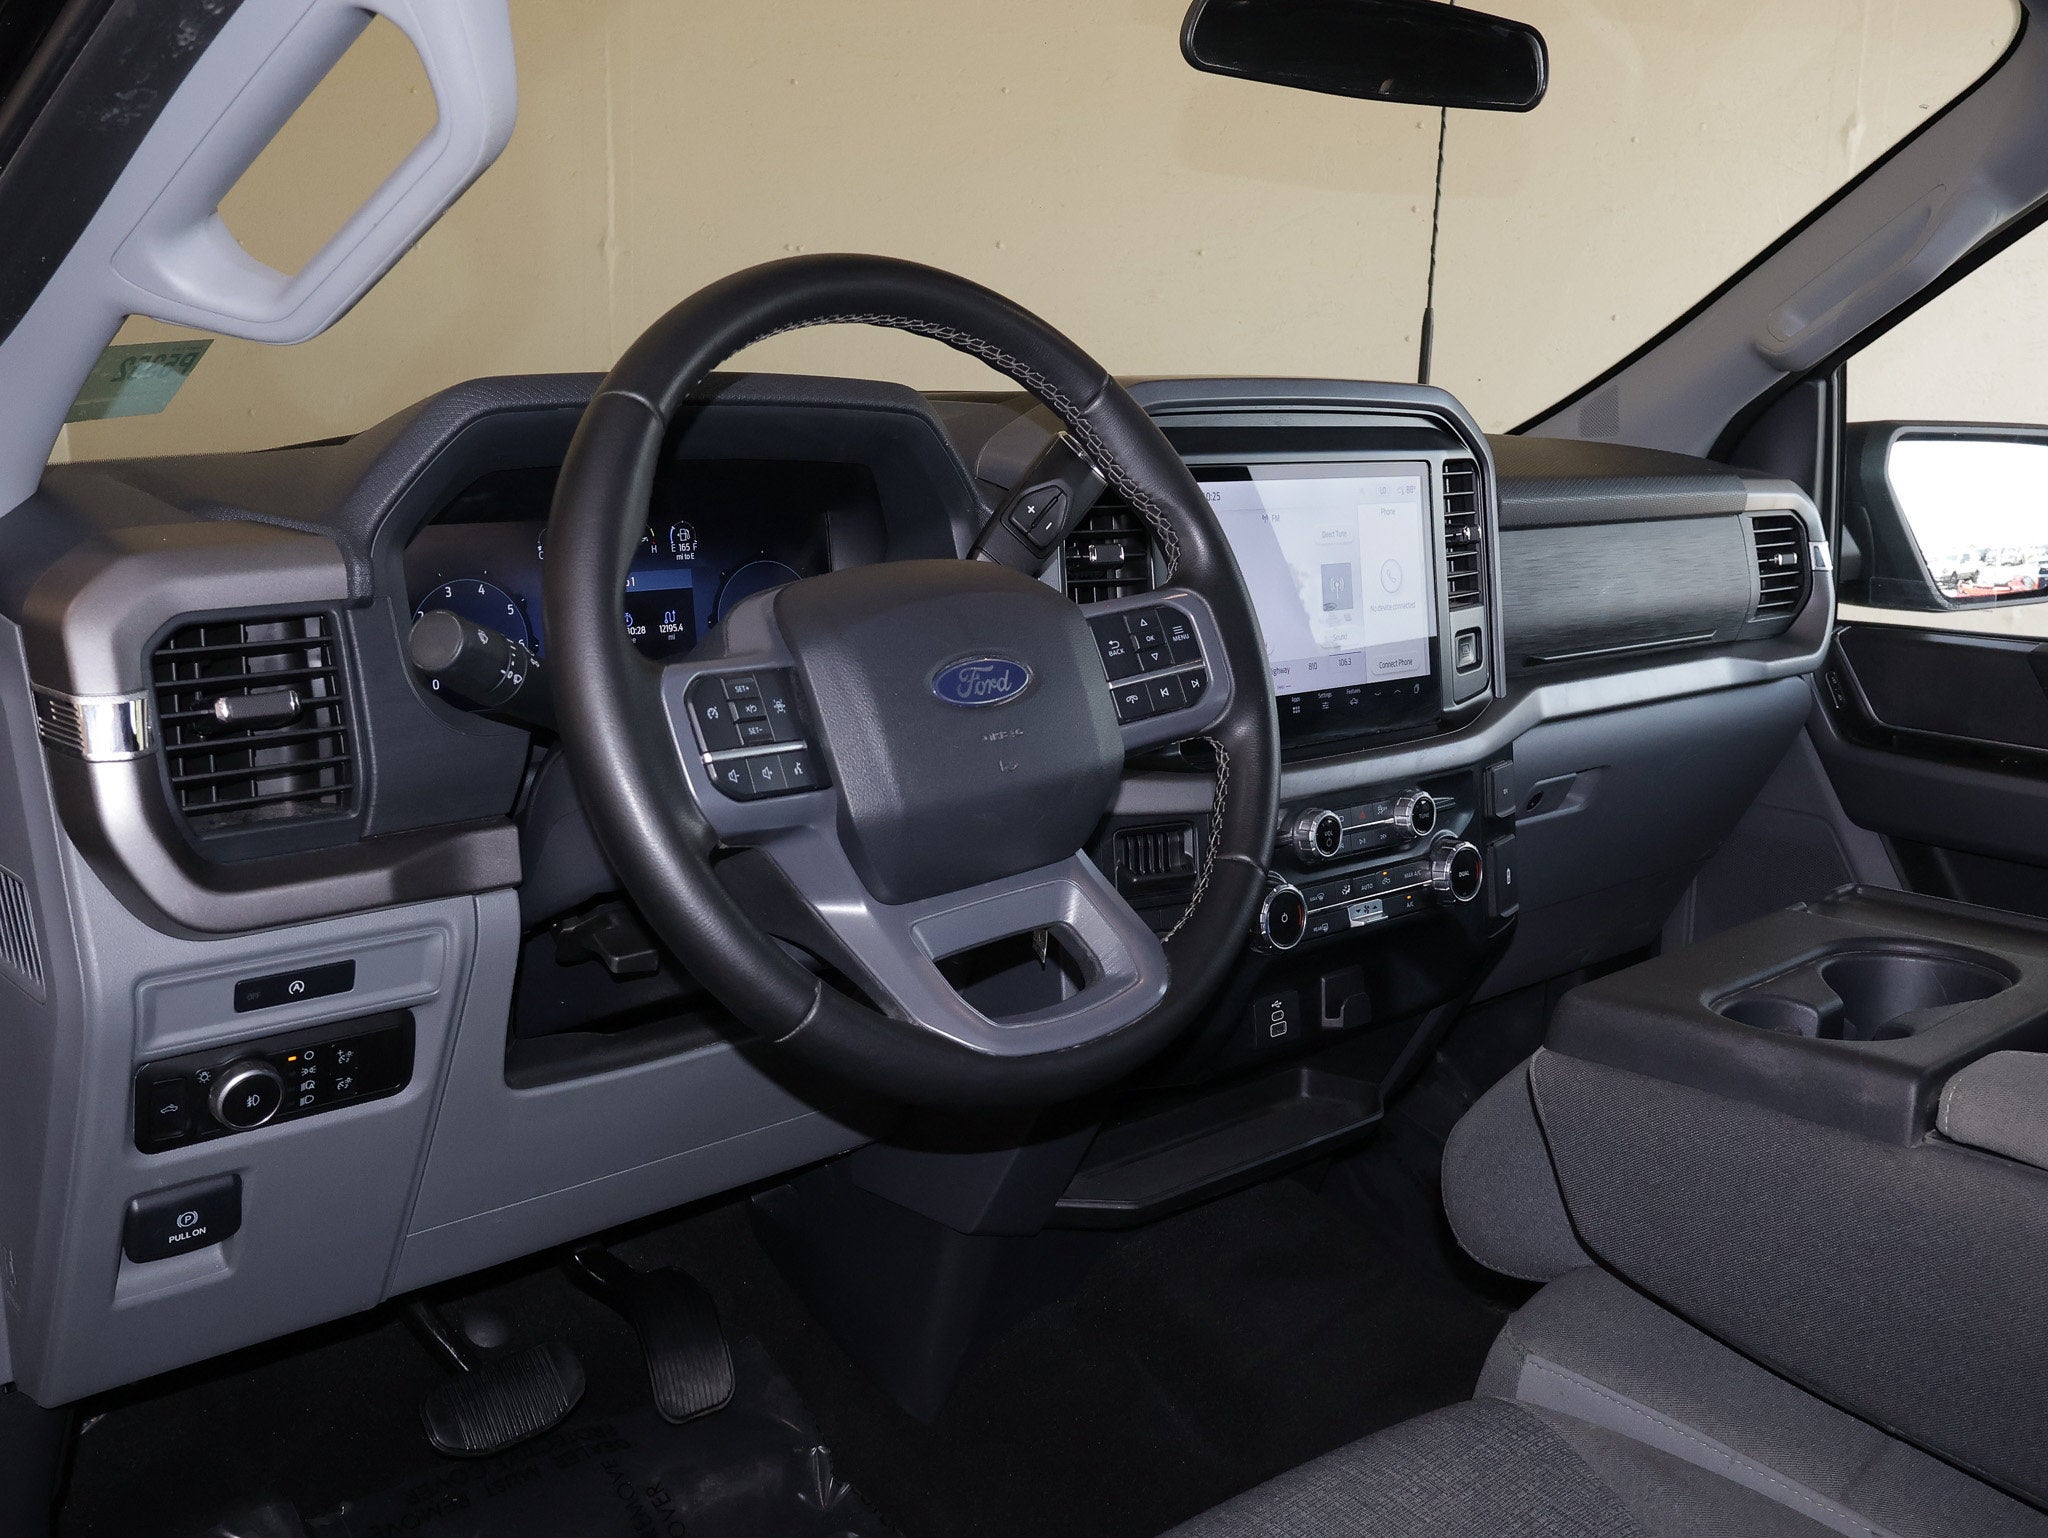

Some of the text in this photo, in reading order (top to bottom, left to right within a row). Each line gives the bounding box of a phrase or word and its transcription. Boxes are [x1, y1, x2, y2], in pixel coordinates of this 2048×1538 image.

[651, 544, 658, 553] H
[671, 544, 676, 552] E
[678, 543, 691, 552] 165
[444, 586, 452, 598] 3
[478, 583, 486, 595] 4
[507, 604, 515, 615] 5
[659, 623, 684, 633] 12195.4
[1172, 633, 1190, 642] MENU
[1108, 648, 1126, 657] BACK
[1272, 666, 1291, 677] ghway
[1338, 657, 1352, 667] 106.3
[1379, 658, 1413, 669] Connect Phone
[432, 678, 440, 690] 0
[957, 665, 1013, 698] Ford
[1404, 869, 1422, 879] MAX A/C
[1458, 870, 1470, 878] DUAL
[1361, 883, 1373, 891] AUTO
[1406, 901, 1414, 909] A/C
[168, 1226, 207, 1243] PULL ON
[645, 1481, 686, 1538] OVER
